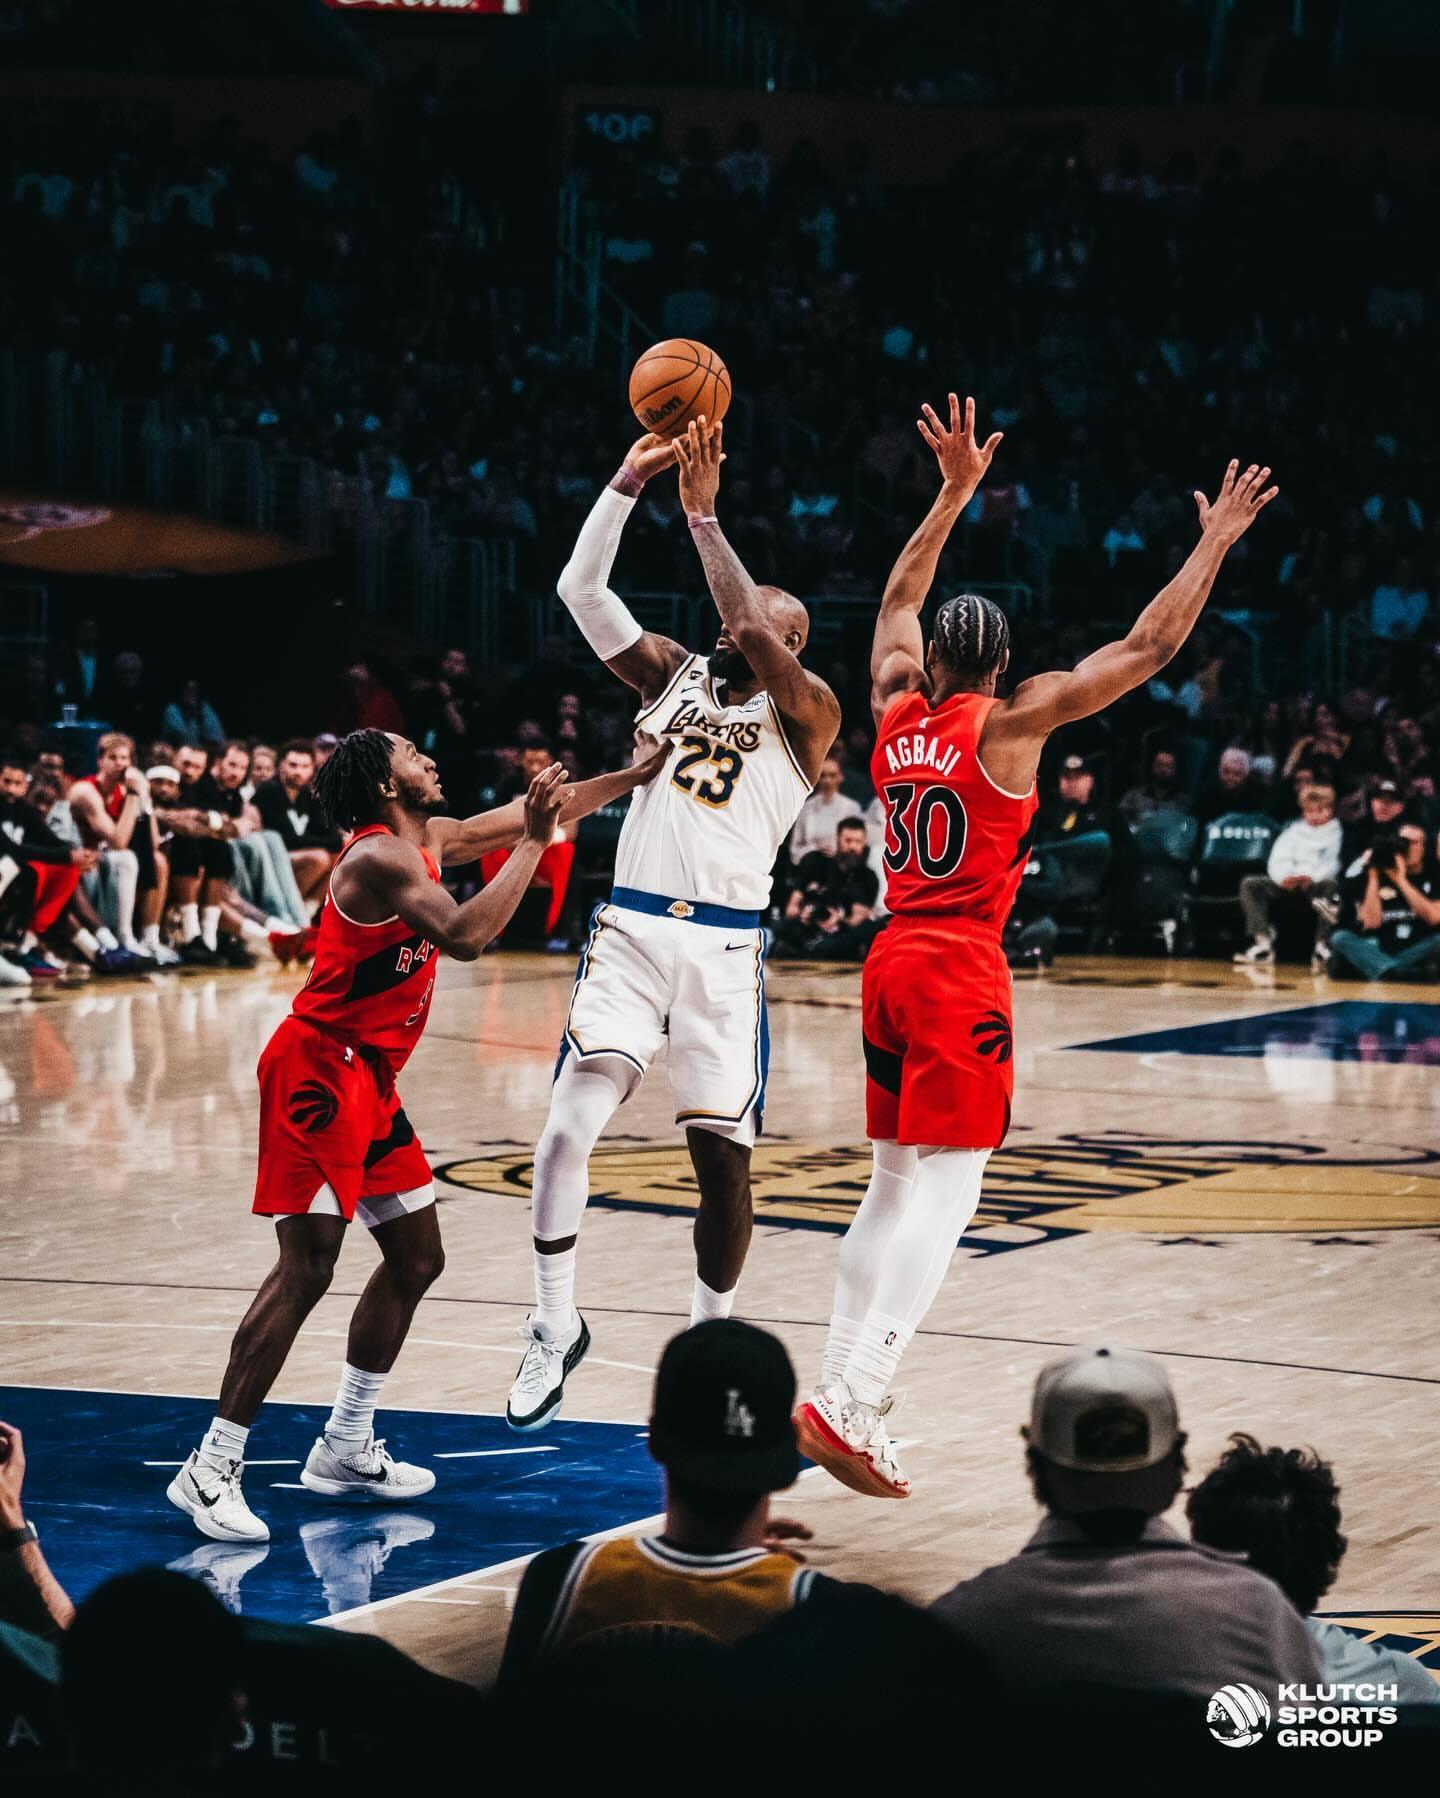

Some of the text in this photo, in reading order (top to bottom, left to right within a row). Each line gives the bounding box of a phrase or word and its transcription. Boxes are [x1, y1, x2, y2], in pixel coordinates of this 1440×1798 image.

[671, 735, 743, 809] 23
[885, 735, 961, 777] AGBAJI
[881, 783, 968, 879] 30
